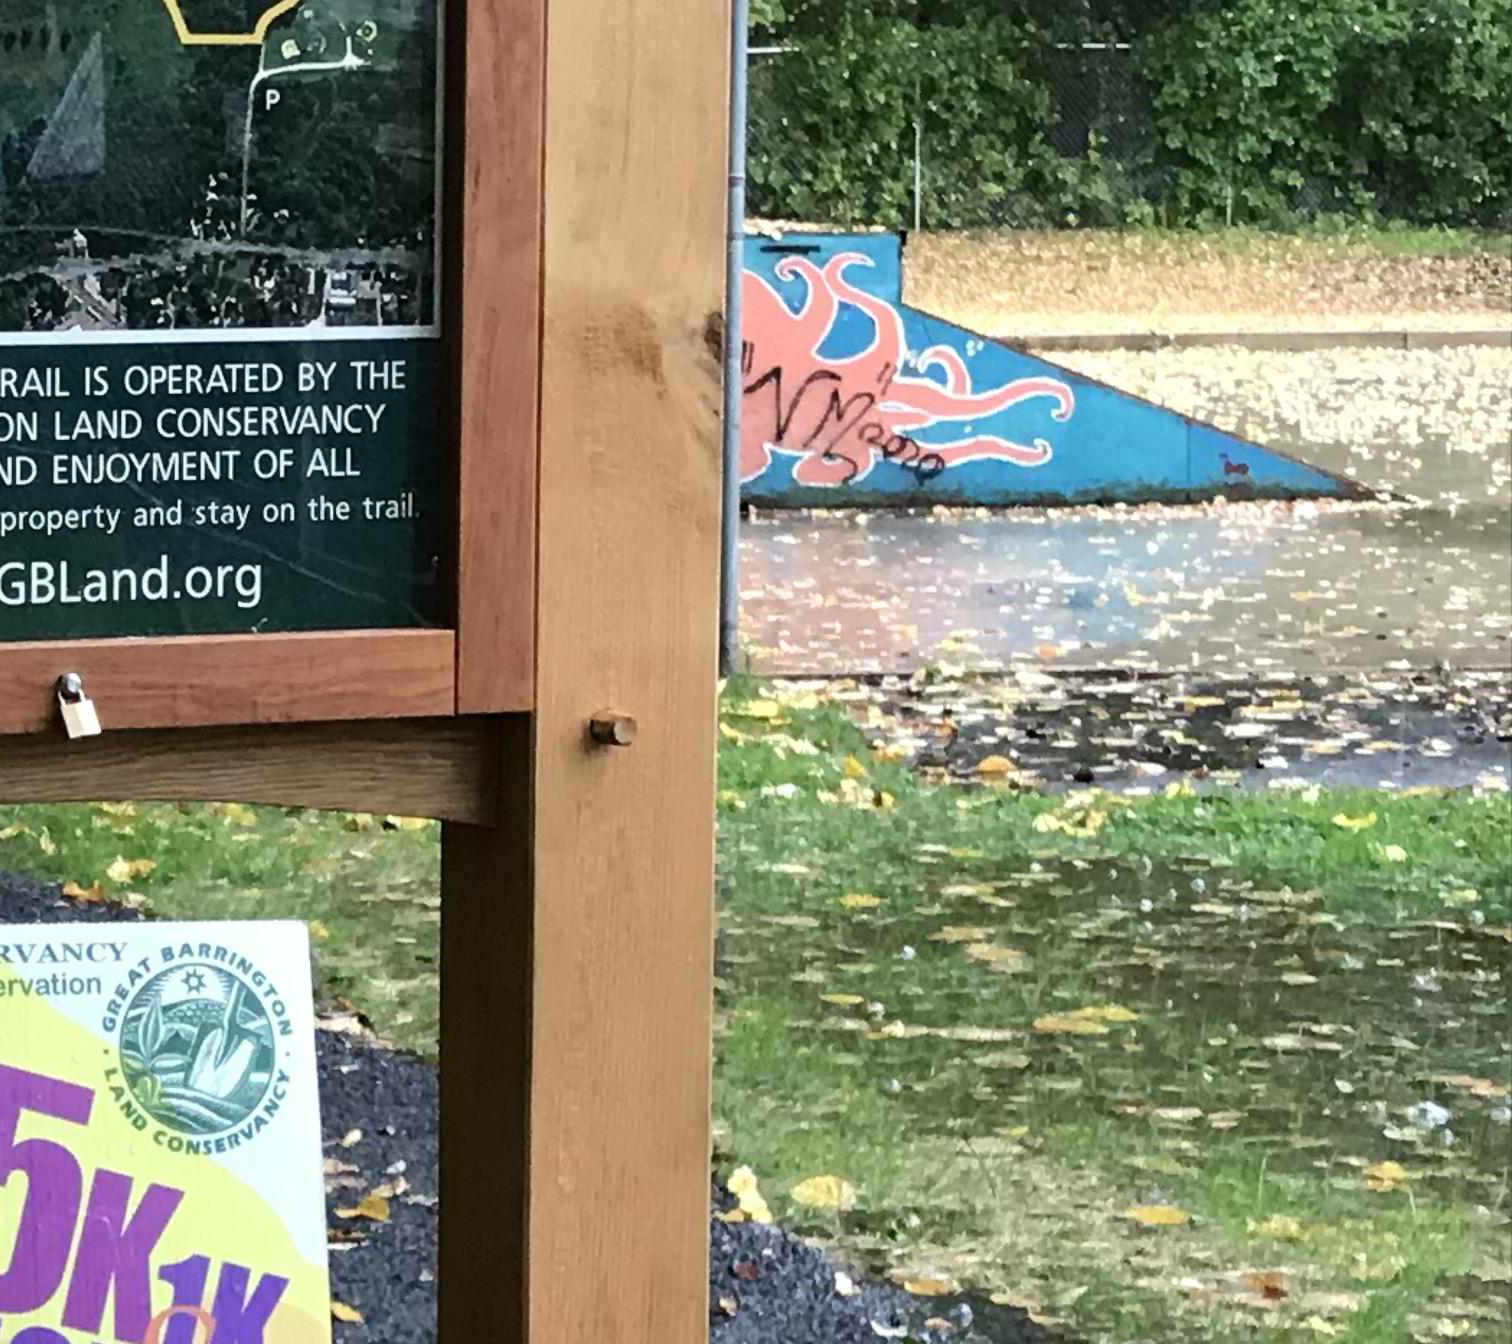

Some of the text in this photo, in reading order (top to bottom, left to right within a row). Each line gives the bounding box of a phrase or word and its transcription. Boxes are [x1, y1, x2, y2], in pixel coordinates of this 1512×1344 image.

[264, 89, 281, 110] P
[83, 366, 109, 396] IS
[124, 363, 289, 396] OPERATED
[297, 362, 336, 392] BY
[350, 360, 407, 391] THE
[54, 409, 143, 441] LAND
[155, 404, 386, 439] CONSERVANCY
[52, 451, 239, 485] ENJOYMENT
[254, 449, 295, 479] OF
[306, 446, 361, 478] ALL
[0, 503, 122, 539] property
[132, 498, 184, 528] and
[194, 498, 251, 532] stay
[262, 500, 296, 523] on
[306, 493, 350, 522] the
[102, 942, 293, 1036] GREAT BARRINGTON
[104, 1067, 291, 1156] LAND CONSERVANCY
